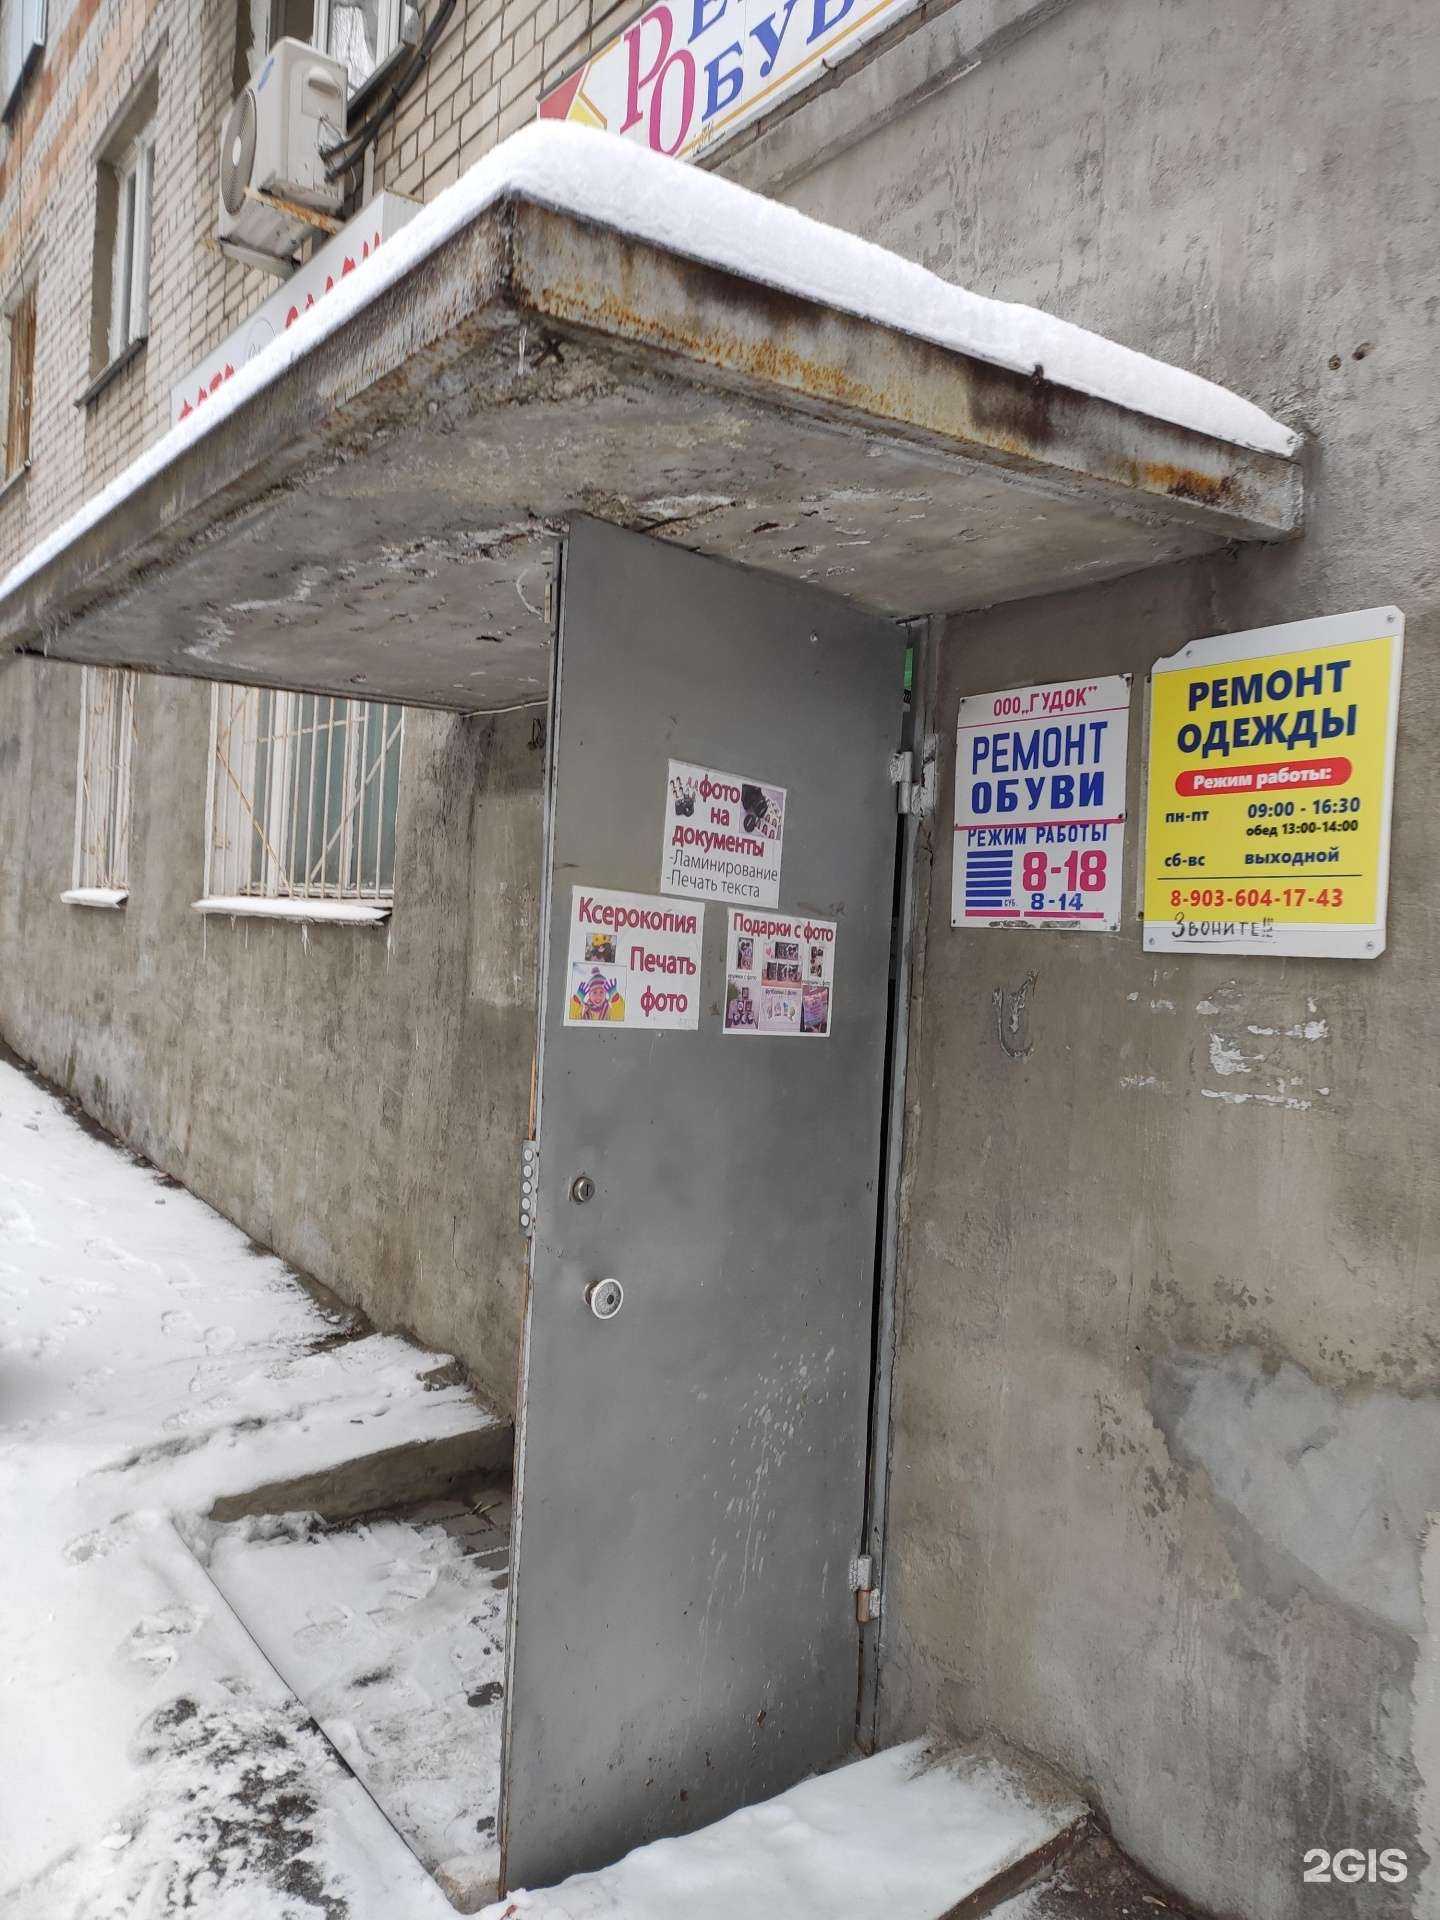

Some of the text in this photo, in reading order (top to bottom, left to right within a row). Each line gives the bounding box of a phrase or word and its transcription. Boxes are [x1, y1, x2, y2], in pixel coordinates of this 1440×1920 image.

[1188, 659, 1351, 712] РЕМОНТ
[1177, 704, 1357, 759] ОДЕЖДЫ
[972, 721, 1108, 775] РЕМОНТ
[699, 774, 741, 804] фото
[971, 771, 1105, 814] ОБУВИ
[1193, 766, 1332, 790] Режим работы:
[710, 807, 730, 827] на
[1165, 809, 1210, 823] пн-пт
[1247, 802, 1295, 818] 09:00
[1312, 797, 1361, 815] 16:30
[671, 825, 765, 858] документы
[967, 823, 1108, 847] РЕЖИМ РАБОТЫ
[1246, 819, 1359, 838] обед 13:00-14:00
[1022, 850, 1107, 892] 8-18
[1164, 847, 1340, 867] сб-вс выходной
[720, 880, 760, 899] текста
[1170, 888, 1344, 907] 8-903-604-17-43
[579, 896, 697, 934] Ксерокопия
[734, 912, 834, 944] Подарки с фото
[630, 946, 697, 975] Печать
[640, 985, 688, 1017] фото
